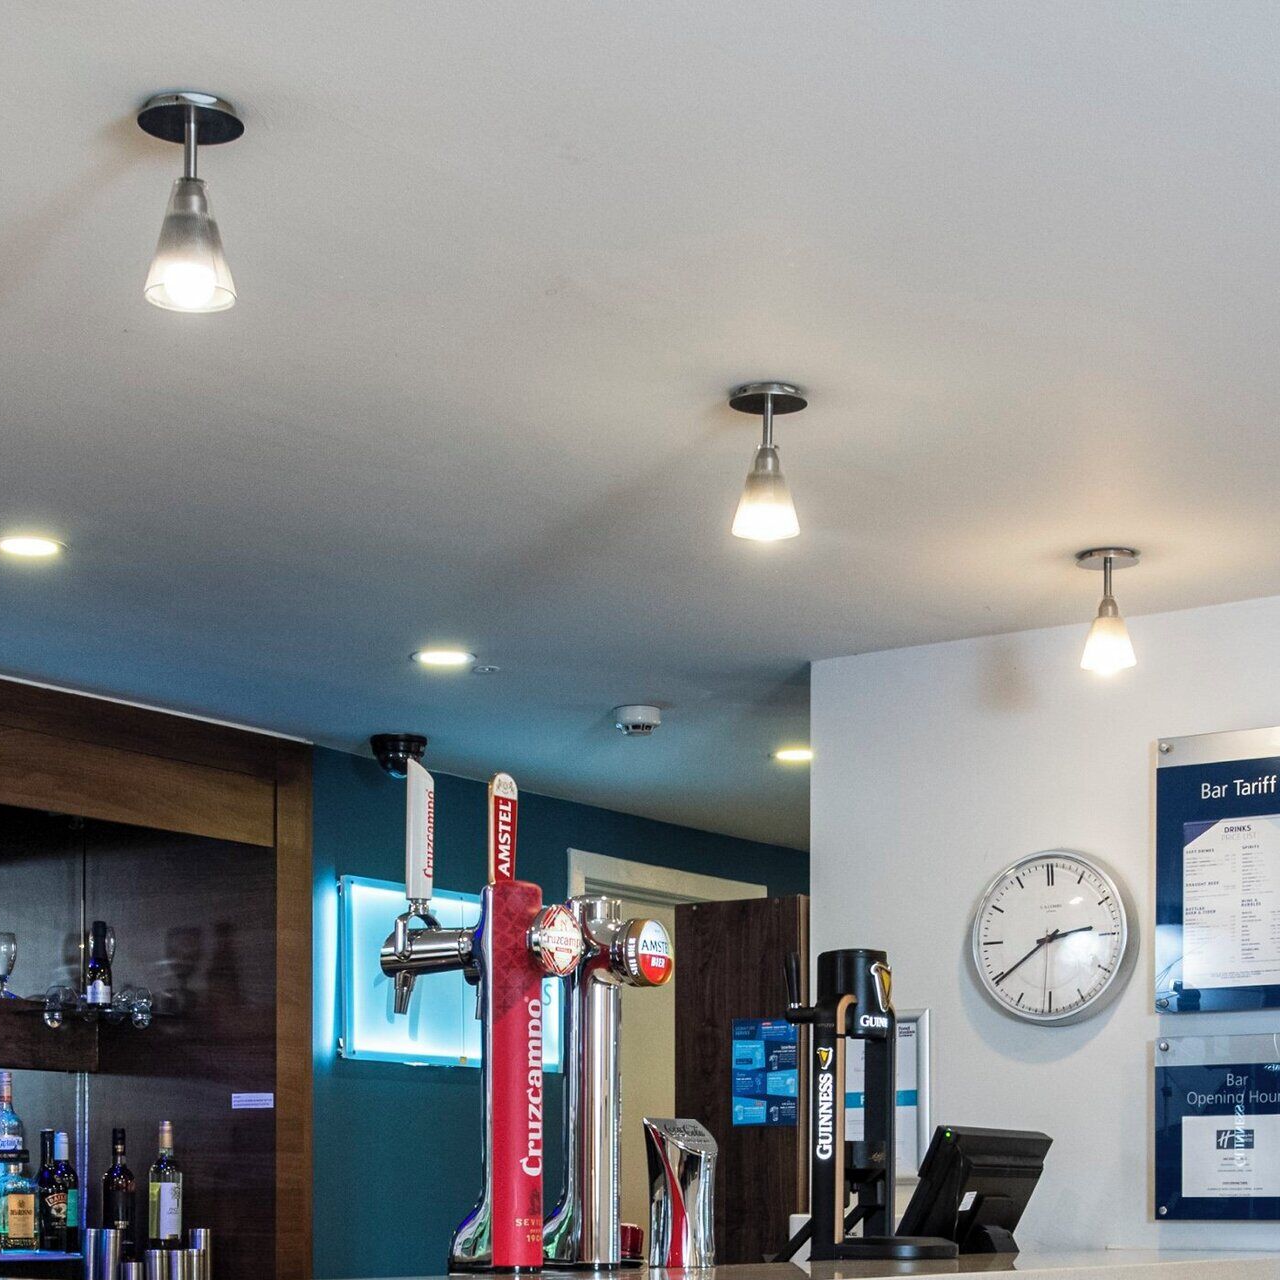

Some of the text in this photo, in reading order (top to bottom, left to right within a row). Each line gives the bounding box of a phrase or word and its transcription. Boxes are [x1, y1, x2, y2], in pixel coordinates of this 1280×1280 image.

[1201, 775, 1277, 800] Bar Tariff
[1224, 825, 1252, 833] DRINKS
[498, 802, 512, 877] AMSTEL
[641, 939, 669, 954] AMSTE
[651, 957, 666, 968] BIER
[1226, 1073, 1249, 1087] Bar
[1187, 1090, 1245, 1107] Opening
[816, 1072, 833, 1161] GUINNESS
